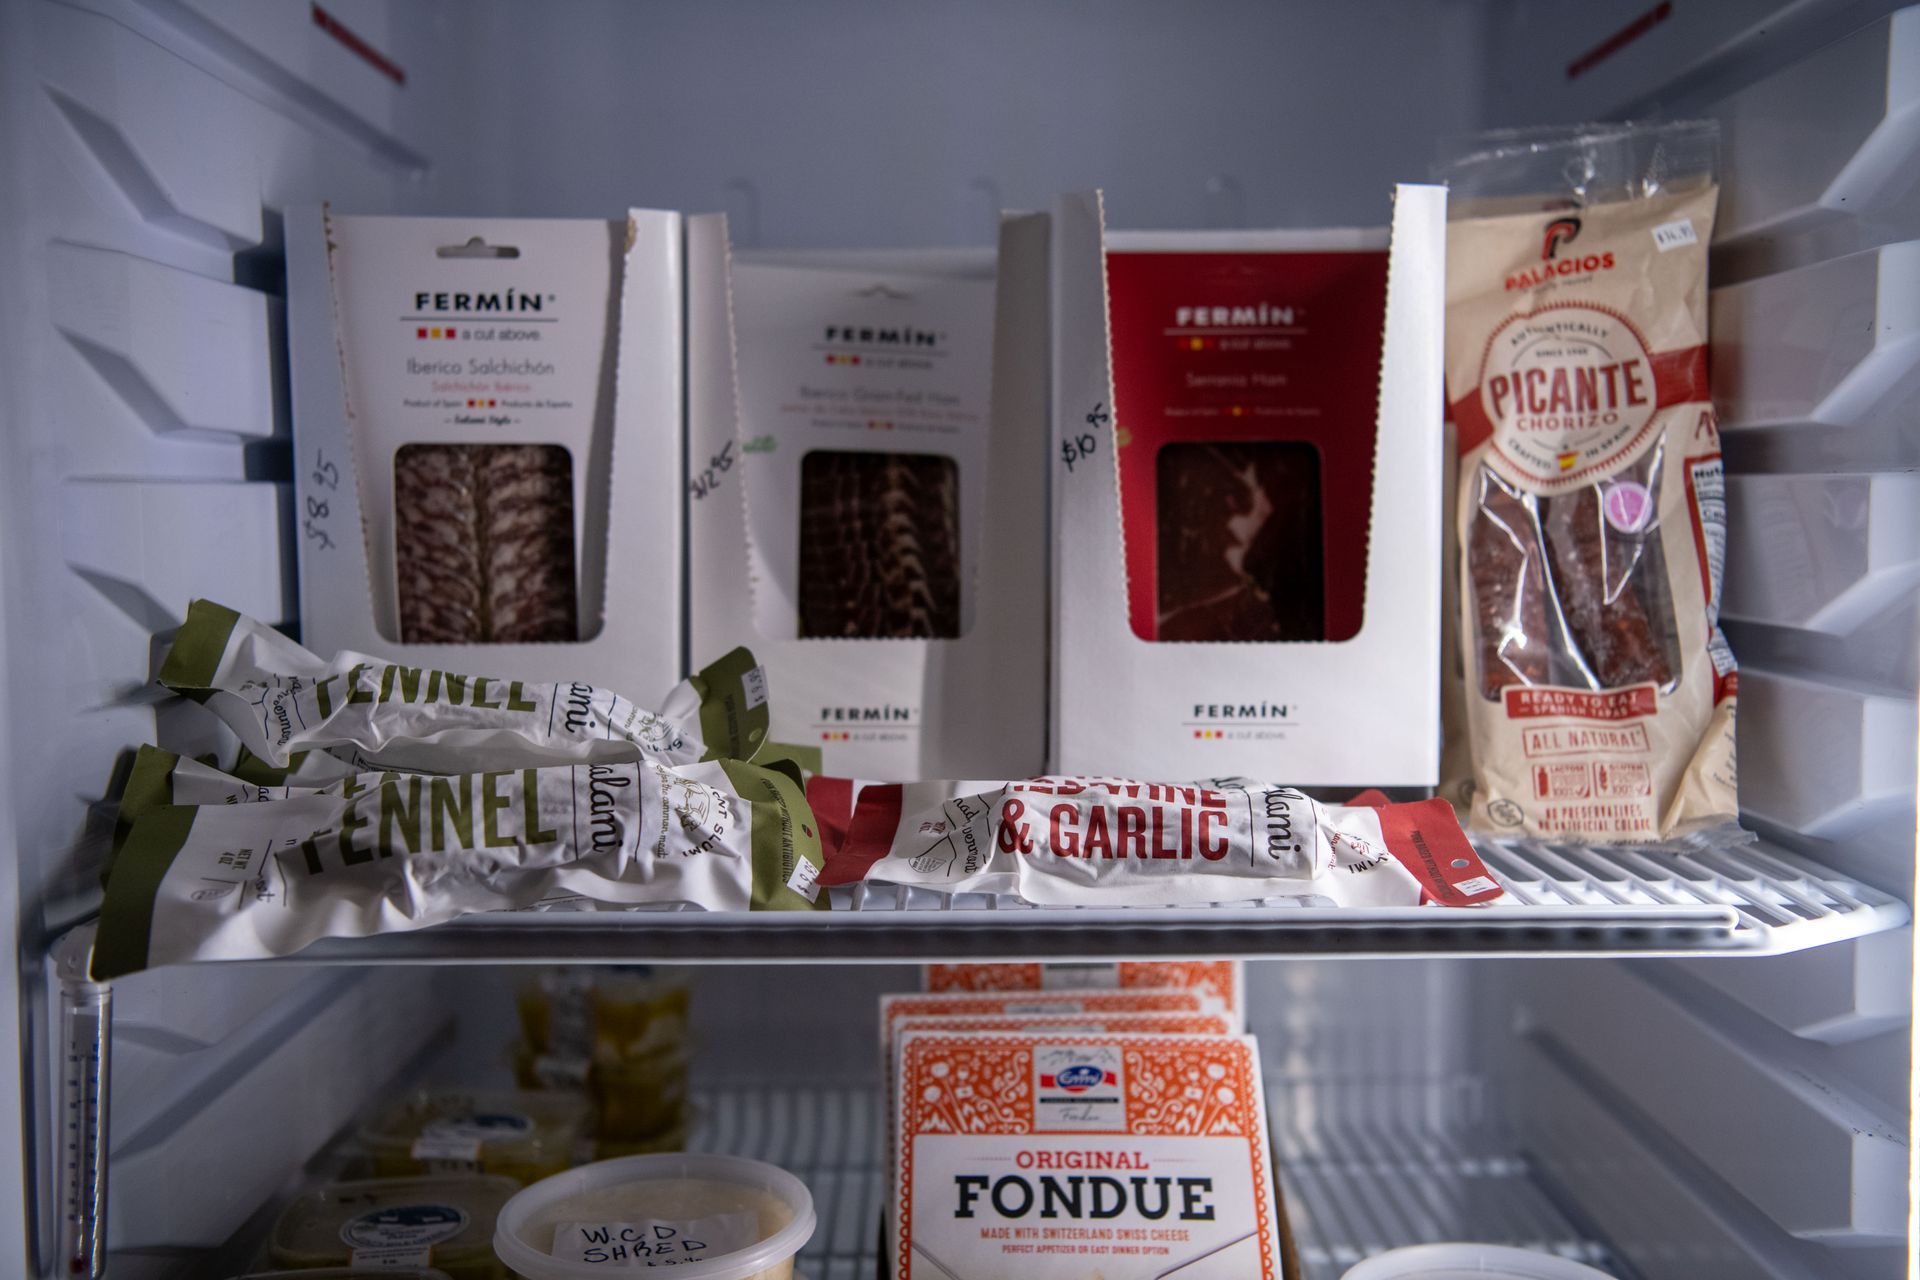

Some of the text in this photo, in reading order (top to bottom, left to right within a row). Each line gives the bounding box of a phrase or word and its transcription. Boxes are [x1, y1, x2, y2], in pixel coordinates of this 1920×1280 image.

[1504, 252, 1616, 292] PALACIOS
[415, 288, 543, 312] FERMÍN
[1176, 301, 1294, 327] FERMÍN
[473, 328, 495, 341] cut
[498, 328, 540, 342] above
[406, 356, 556, 377] Iberico Salchichón
[1489, 359, 1648, 420] PICANTE
[1516, 412, 1619, 432] CHORIZO
[1520, 691, 1639, 708] READY TO EAT
[821, 704, 910, 721] FERMÍN
[1193, 701, 1288, 719] FERMÍN
[1532, 730, 1638, 750] ALL NATURAL
[998, 798, 1229, 861] & GARLIC
[1016, 1150, 1150, 1170] ORIGINAL
[953, 1174, 1216, 1222] FONDUE
[980, 1227, 1190, 1242] MADE WITH SWITZERLAND SWISS CHEESE
[584, 1240, 707, 1264] SHRED
[1001, 1244, 1170, 1256] PERFECT APPETIZER OR EASY DINNER OPTION
